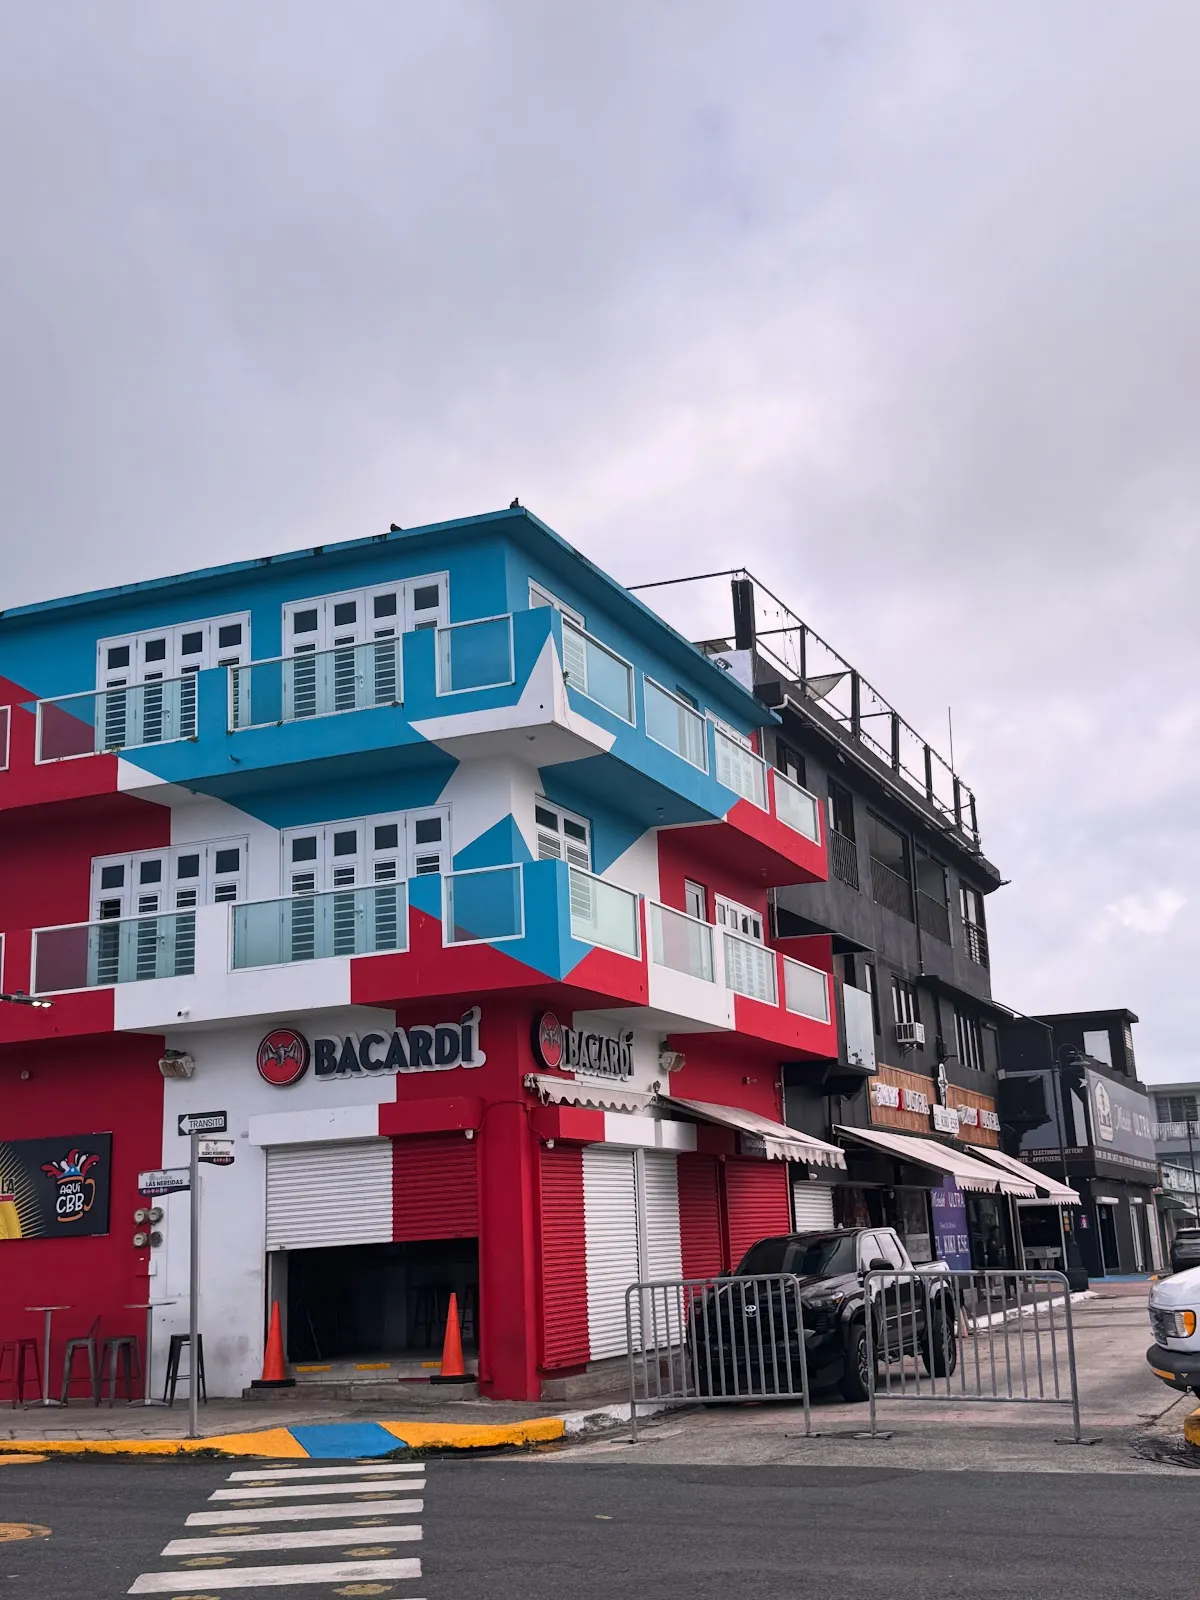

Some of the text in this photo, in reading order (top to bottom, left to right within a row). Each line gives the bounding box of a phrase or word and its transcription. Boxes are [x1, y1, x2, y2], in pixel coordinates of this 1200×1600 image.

[315, 1010, 475, 1075] BACARDÍ
[564, 1031, 634, 1076] BACARDÍ
[904, 1089, 930, 1115] ULTRA
[189, 1117, 224, 1129] TRANSITO
[1133, 1112, 1151, 1138] ULTRA
[146, 1180, 156, 1188] LAS
[56, 1193, 85, 1213] CBB
[948, 1191, 965, 1208] ULTRA
